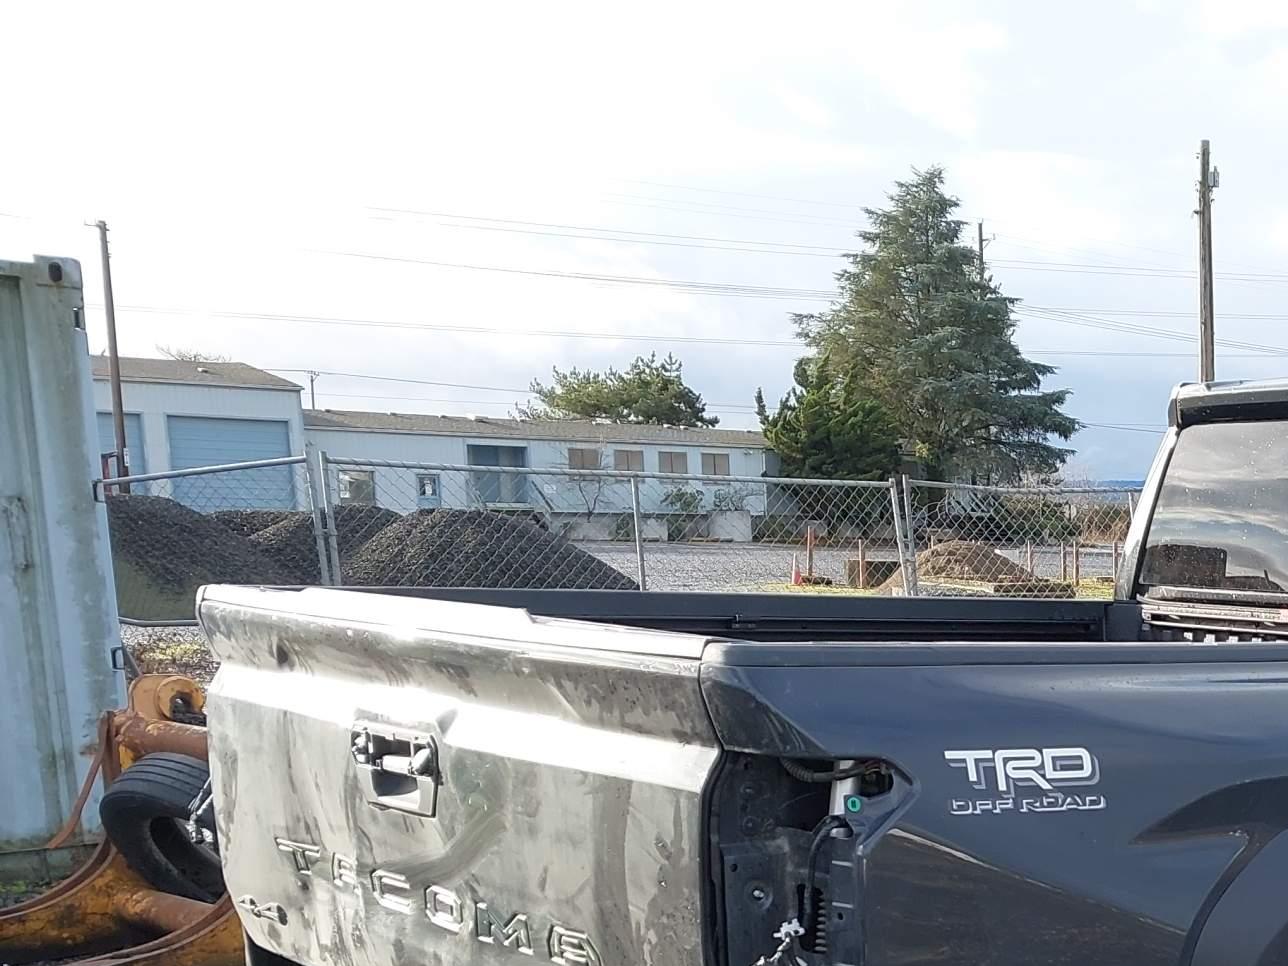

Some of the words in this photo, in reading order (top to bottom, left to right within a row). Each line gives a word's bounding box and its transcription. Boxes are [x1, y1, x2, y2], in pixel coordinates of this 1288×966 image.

[944, 747, 1098, 796] TRD
[950, 797, 1014, 815] OFF
[1019, 795, 1106, 813] ROAD
